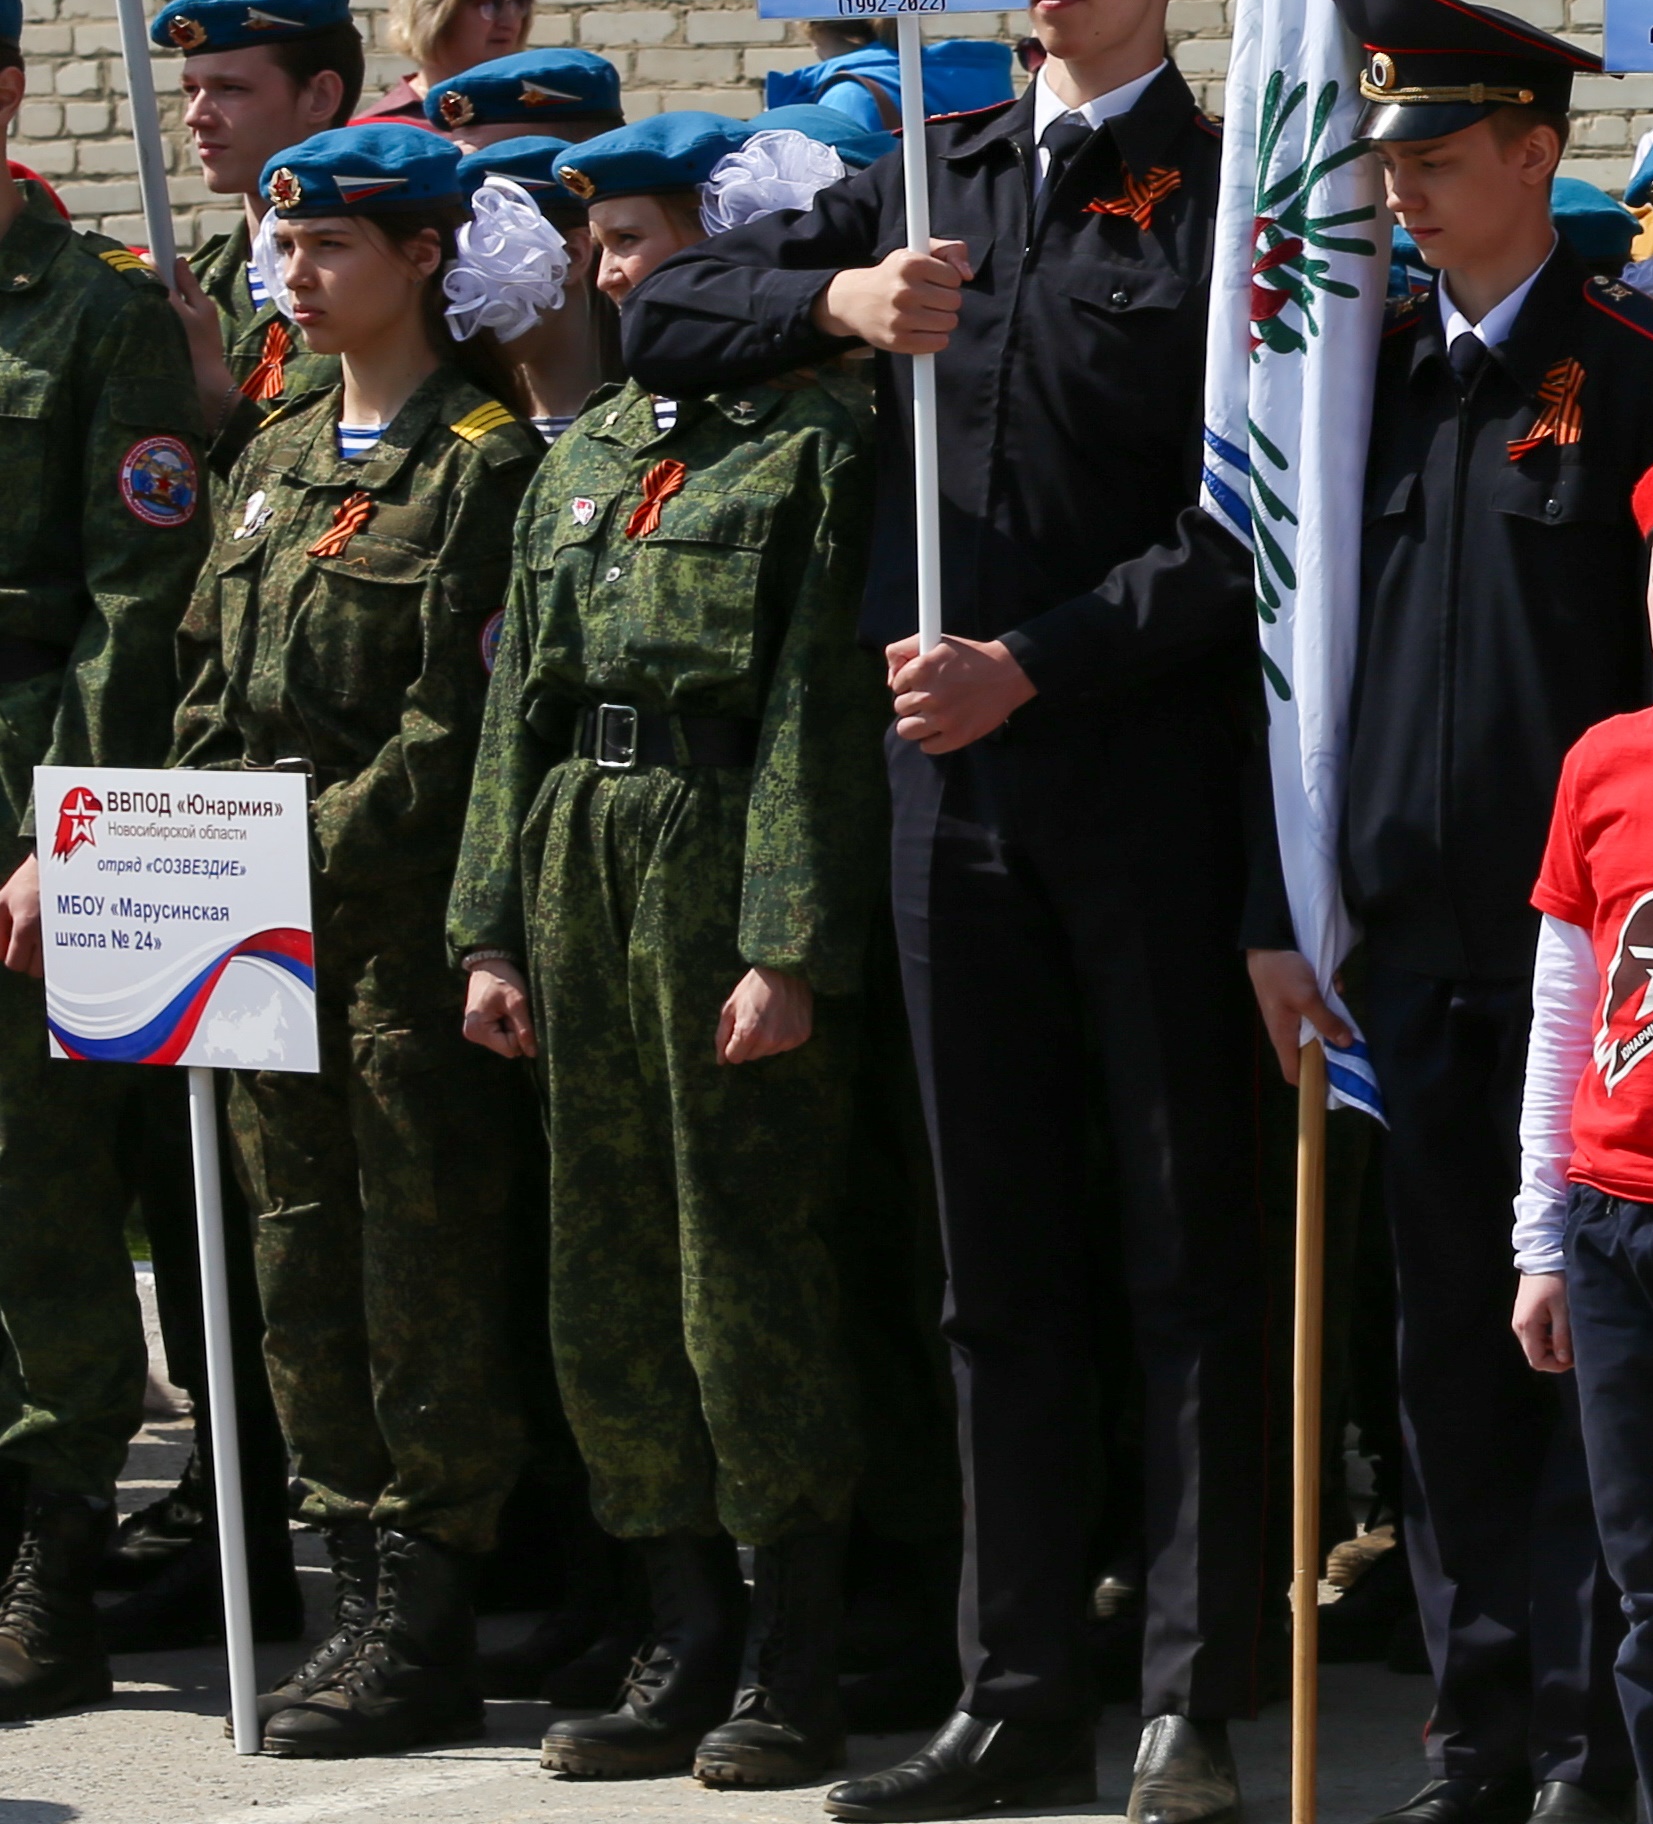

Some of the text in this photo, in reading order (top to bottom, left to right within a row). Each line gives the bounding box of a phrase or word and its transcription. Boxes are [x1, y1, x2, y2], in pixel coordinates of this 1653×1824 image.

[107, 791, 284, 821] ВВПОД «Юнармия»
[107, 821, 247, 841] Новосибирской области
[97, 856, 247, 879] отряд «СОЗВЕЗДИЕ»
[57, 894, 230, 927] МБОУ «Марусинская
[55, 929, 162, 951] школа № 24»
